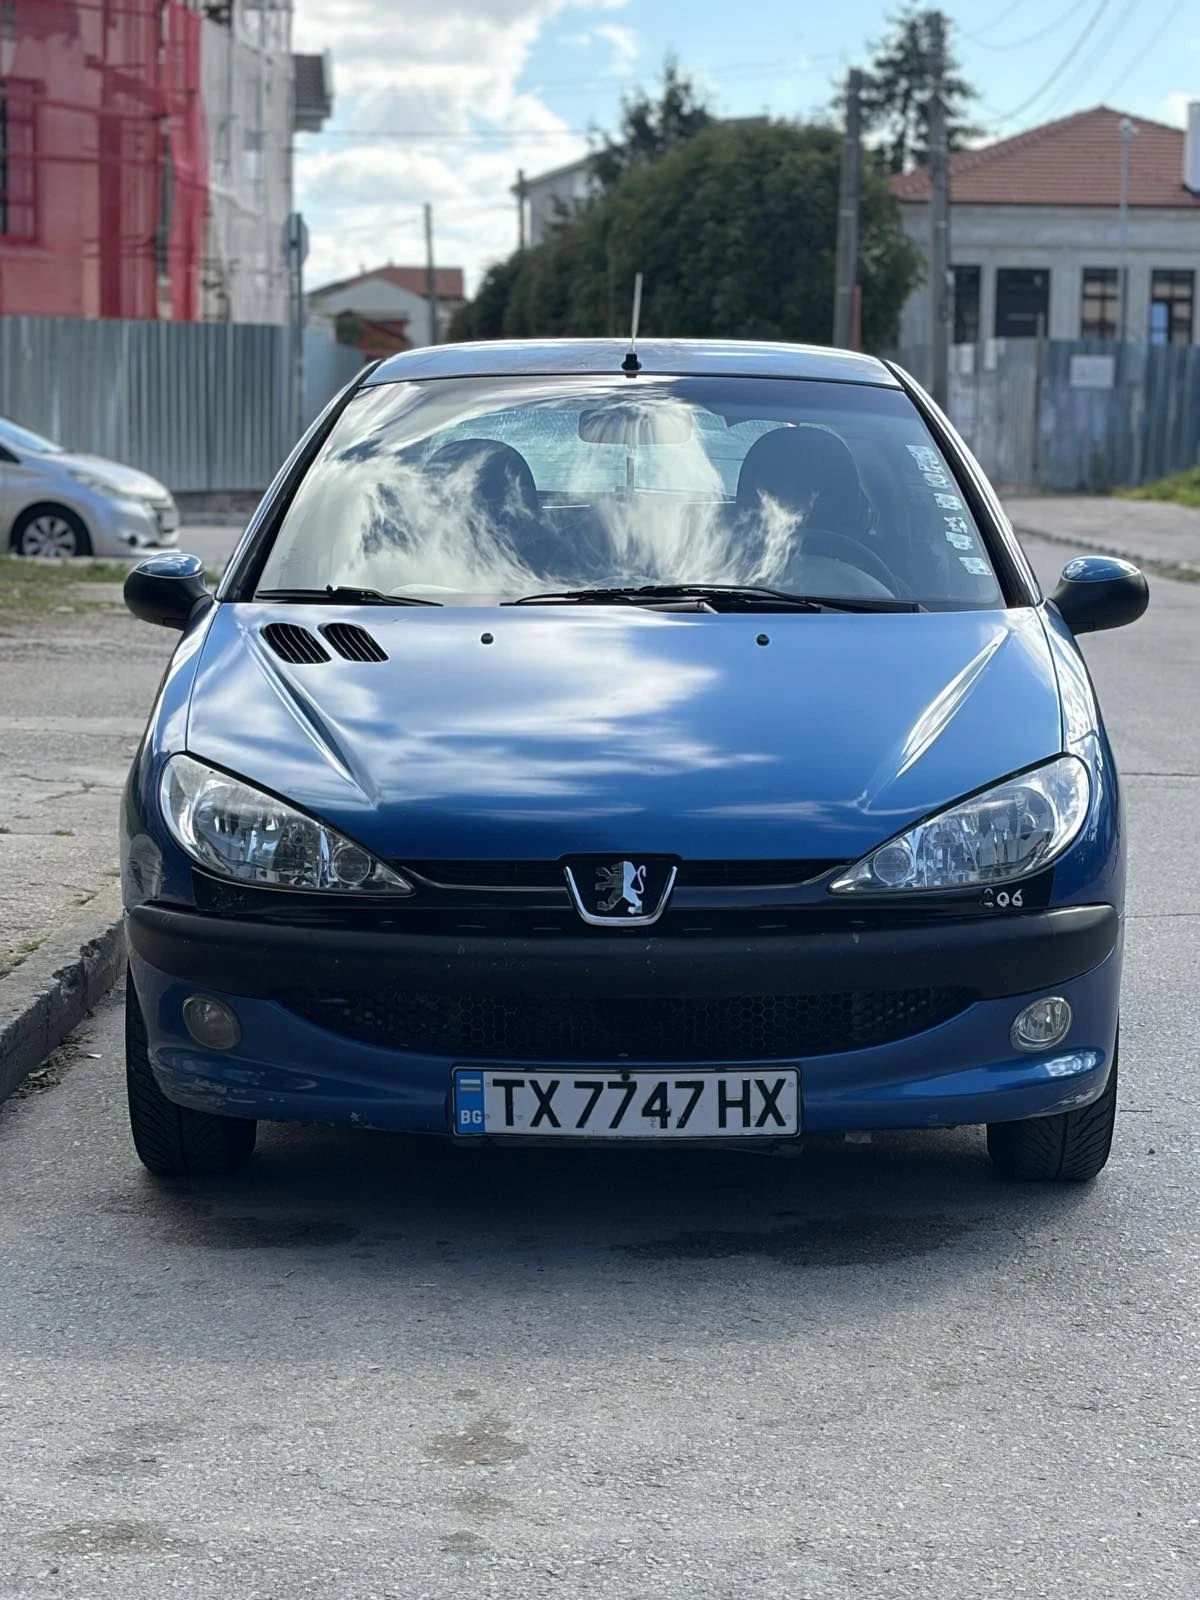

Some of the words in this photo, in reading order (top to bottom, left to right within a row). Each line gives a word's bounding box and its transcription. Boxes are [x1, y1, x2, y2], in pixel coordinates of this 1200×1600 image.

[460, 1110, 482, 1124] BG
[492, 1079, 561, 1127] TX
[574, 1080, 705, 1129] 7747
[717, 1078, 787, 1128] HX
